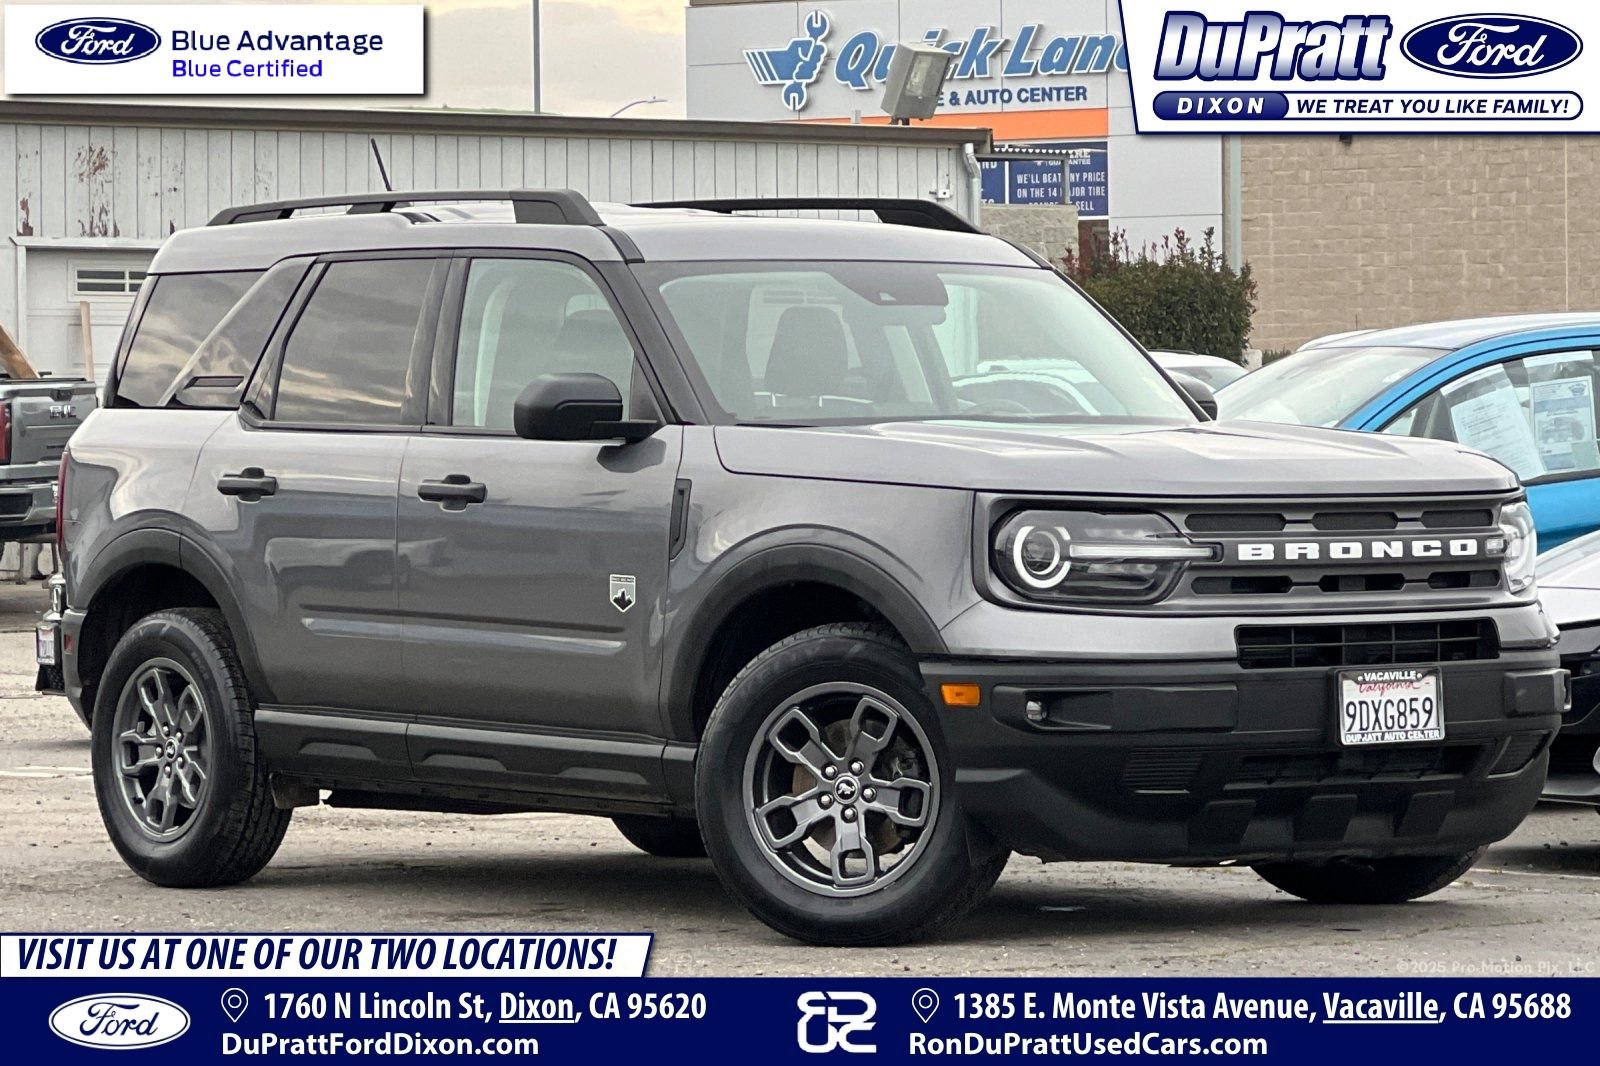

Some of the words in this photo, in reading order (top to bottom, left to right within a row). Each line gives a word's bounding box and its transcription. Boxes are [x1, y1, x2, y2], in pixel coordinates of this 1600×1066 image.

[964, 88, 1013, 105] AUTO
[1017, 85, 1088, 103] CENTER
[1016, 173, 1040, 184] WE'LL
[1043, 172, 1062, 184] BEAT
[1083, 171, 1105, 182] PRICE
[1017, 188, 1028, 198] ON
[1030, 187, 1044, 198] THE
[1048, 187, 1058, 198] 14
[1088, 186, 1106, 197] TIRE
[1075, 200, 1094, 211] SELL
[1238, 538, 1478, 561] BRONCO
[1363, 670, 1416, 681] VACAVILLE
[1345, 696, 1433, 732] 9DXG859
[1384, 731, 1406, 741] AUTO
